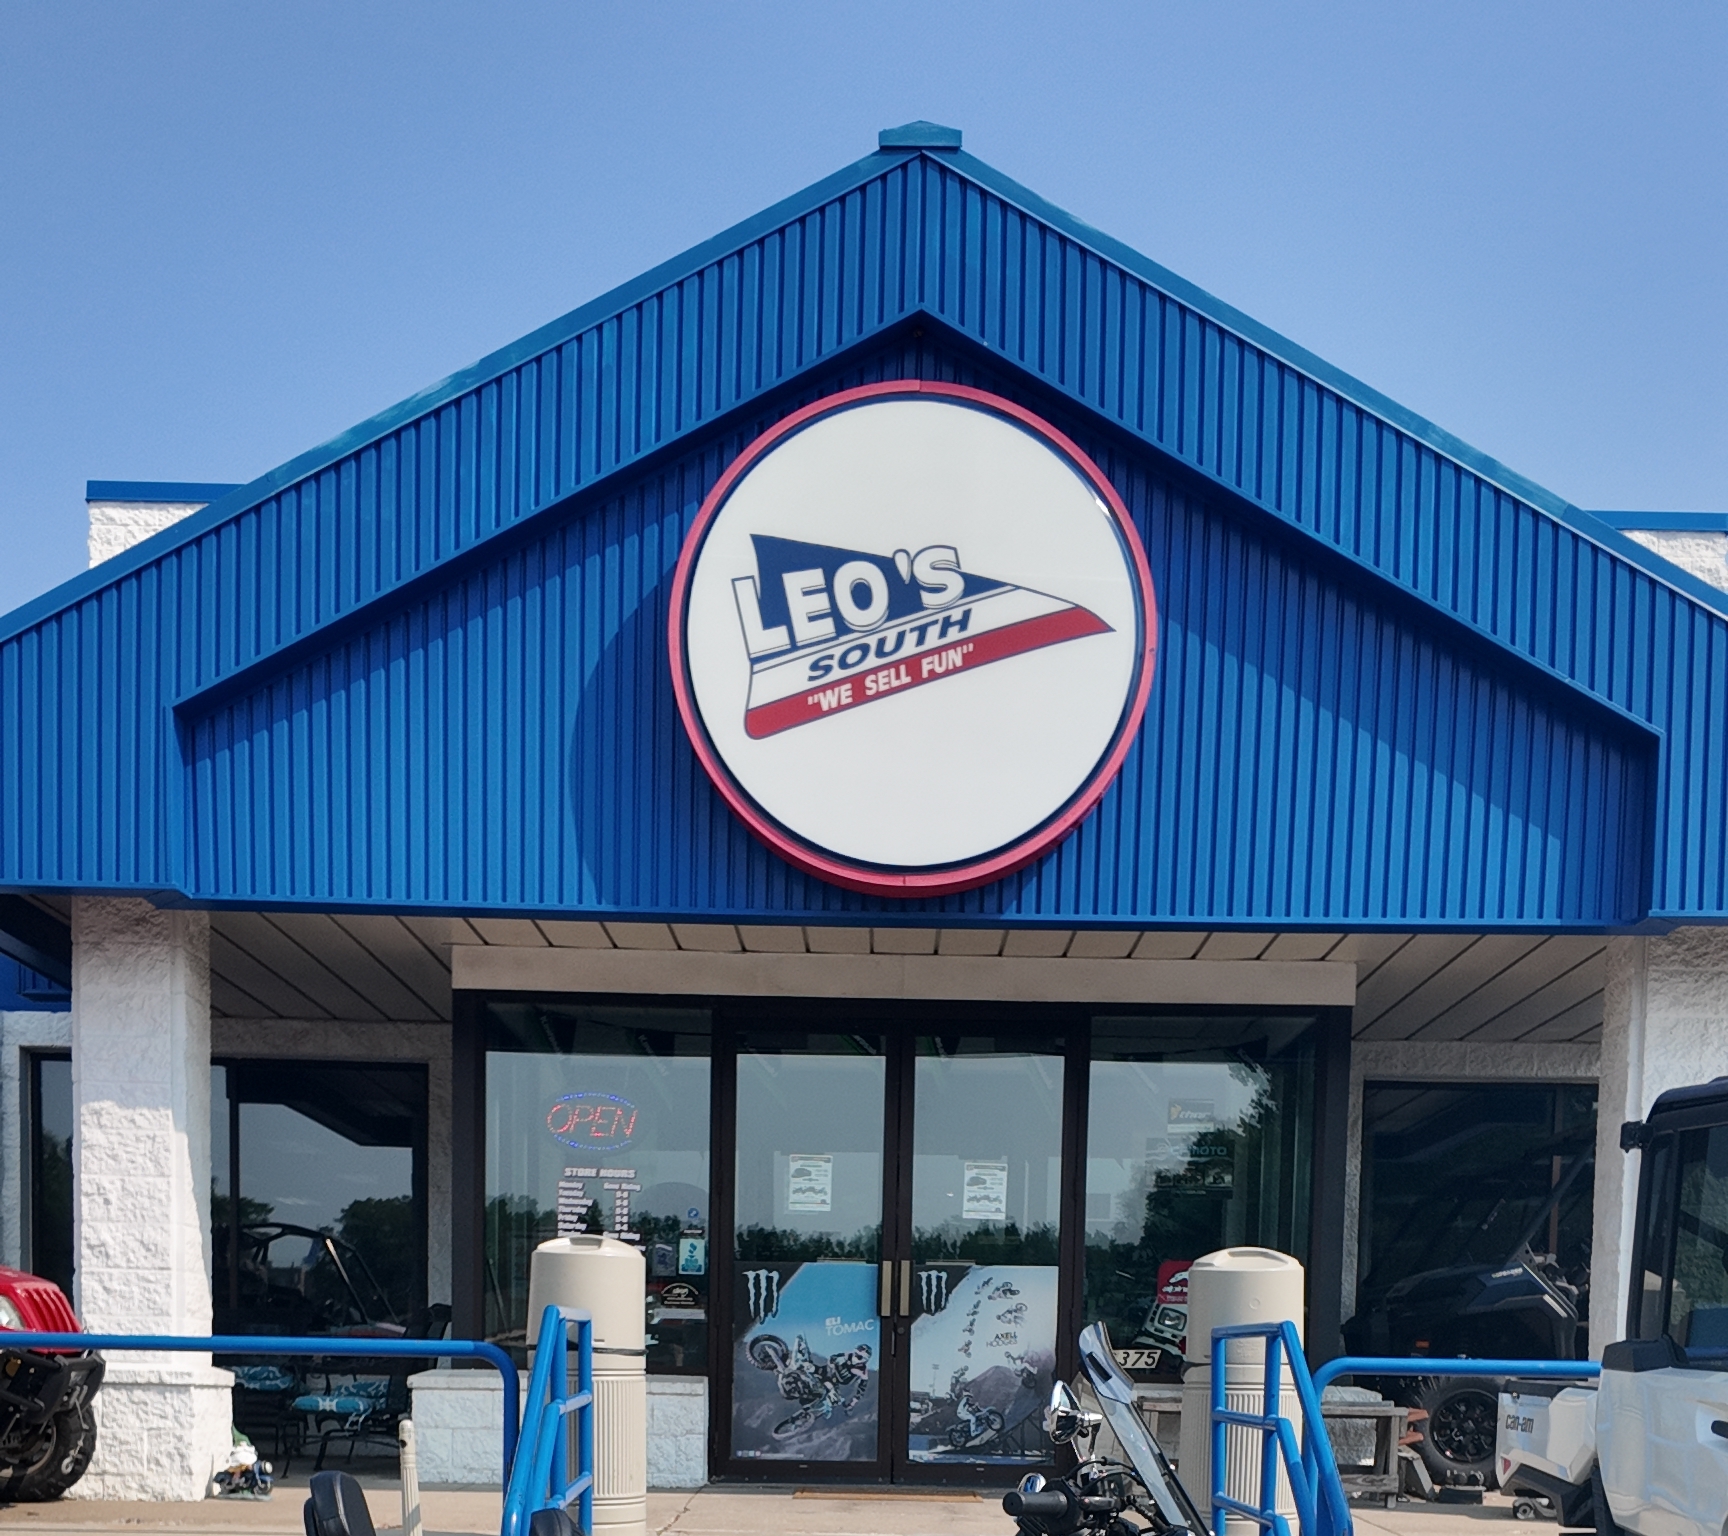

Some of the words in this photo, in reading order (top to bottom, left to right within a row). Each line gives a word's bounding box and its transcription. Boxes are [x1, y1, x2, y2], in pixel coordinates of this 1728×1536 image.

[731, 545, 965, 656] LEO'S
[807, 608, 972, 682] SOUTH
[807, 683, 853, 711] "WE
[864, 664, 912, 696] SELL
[921, 643, 974, 678] FUN"
[546, 1104, 637, 1137] OPEN
[564, 1167, 598, 1177] STORE
[599, 1168, 636, 1179] HOURS
[825, 1319, 875, 1336] TOMAC
[1505, 1414, 1534, 1433] can-am
